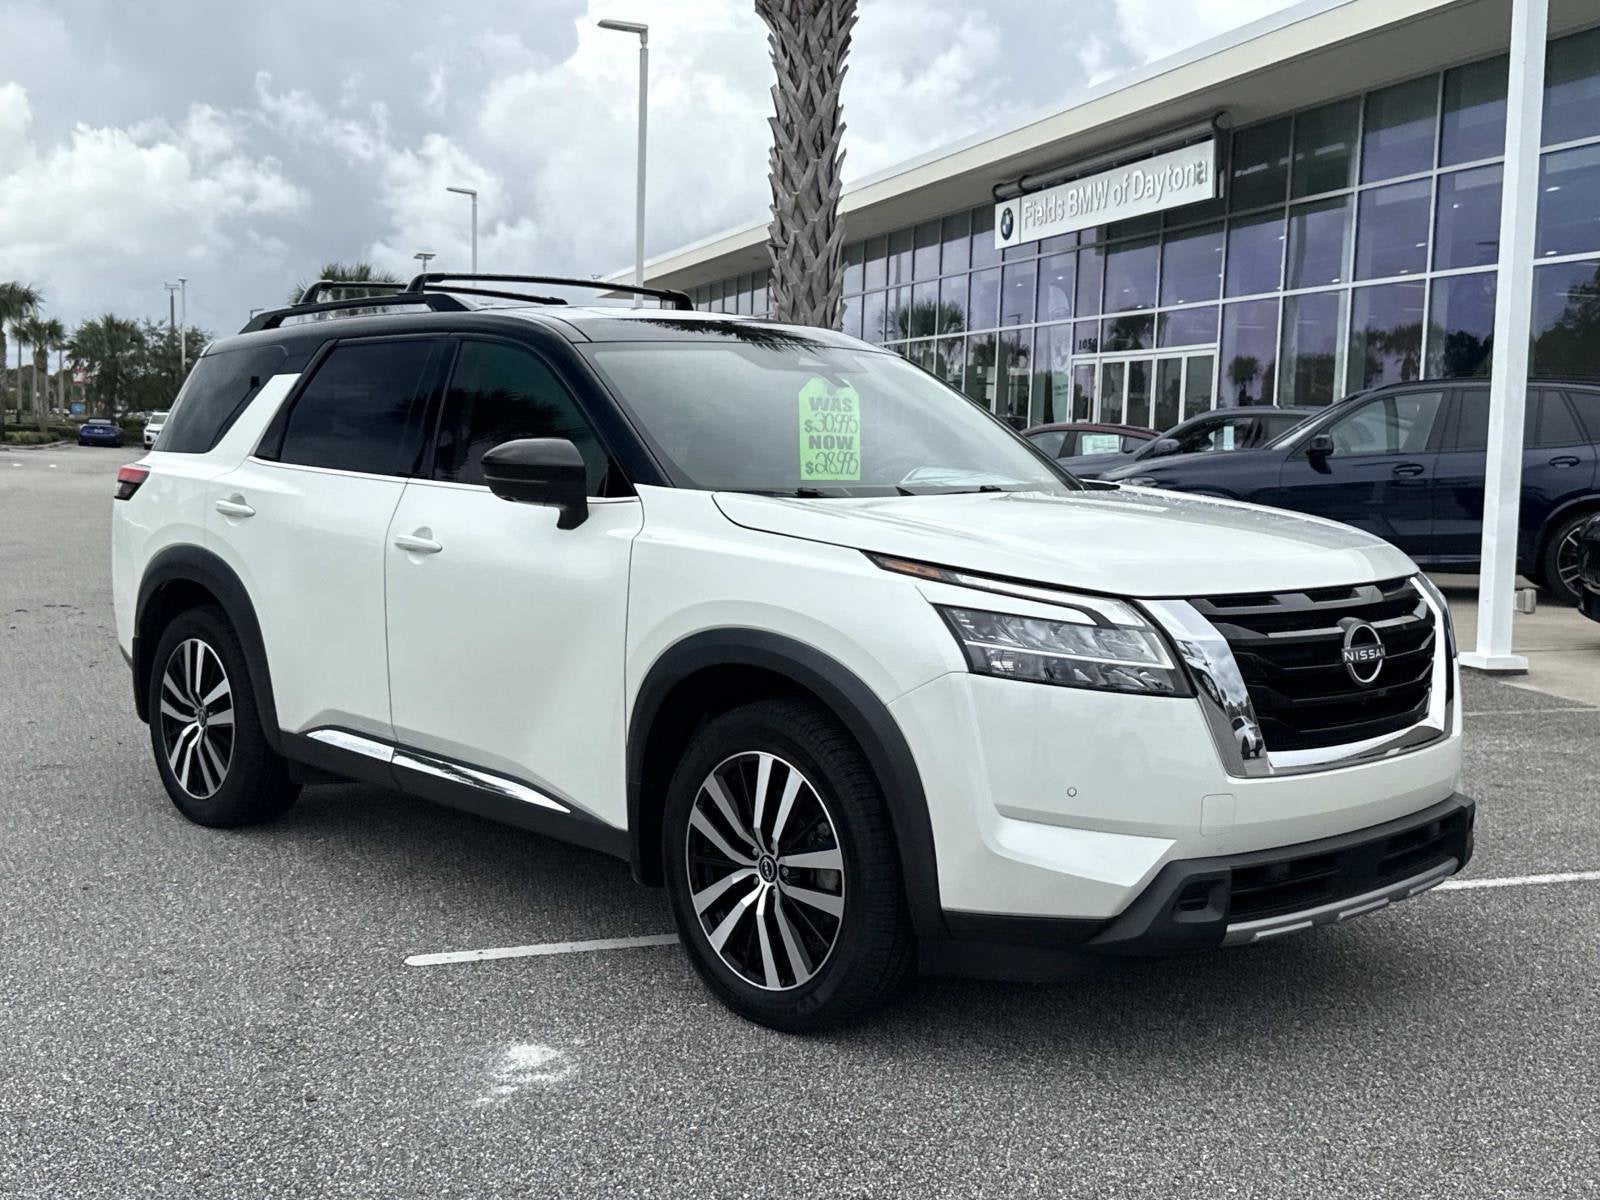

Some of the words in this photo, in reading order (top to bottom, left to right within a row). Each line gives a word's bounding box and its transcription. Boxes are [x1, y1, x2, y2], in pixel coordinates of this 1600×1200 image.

[1023, 198, 1064, 229] Fields
[1068, 178, 1110, 218] BMW
[1113, 172, 1130, 206] of
[1132, 159, 1208, 203] Daytona
[808, 397, 852, 412] WAS
[808, 435, 854, 450] NOW
[1344, 647, 1386, 661] NISSAN
